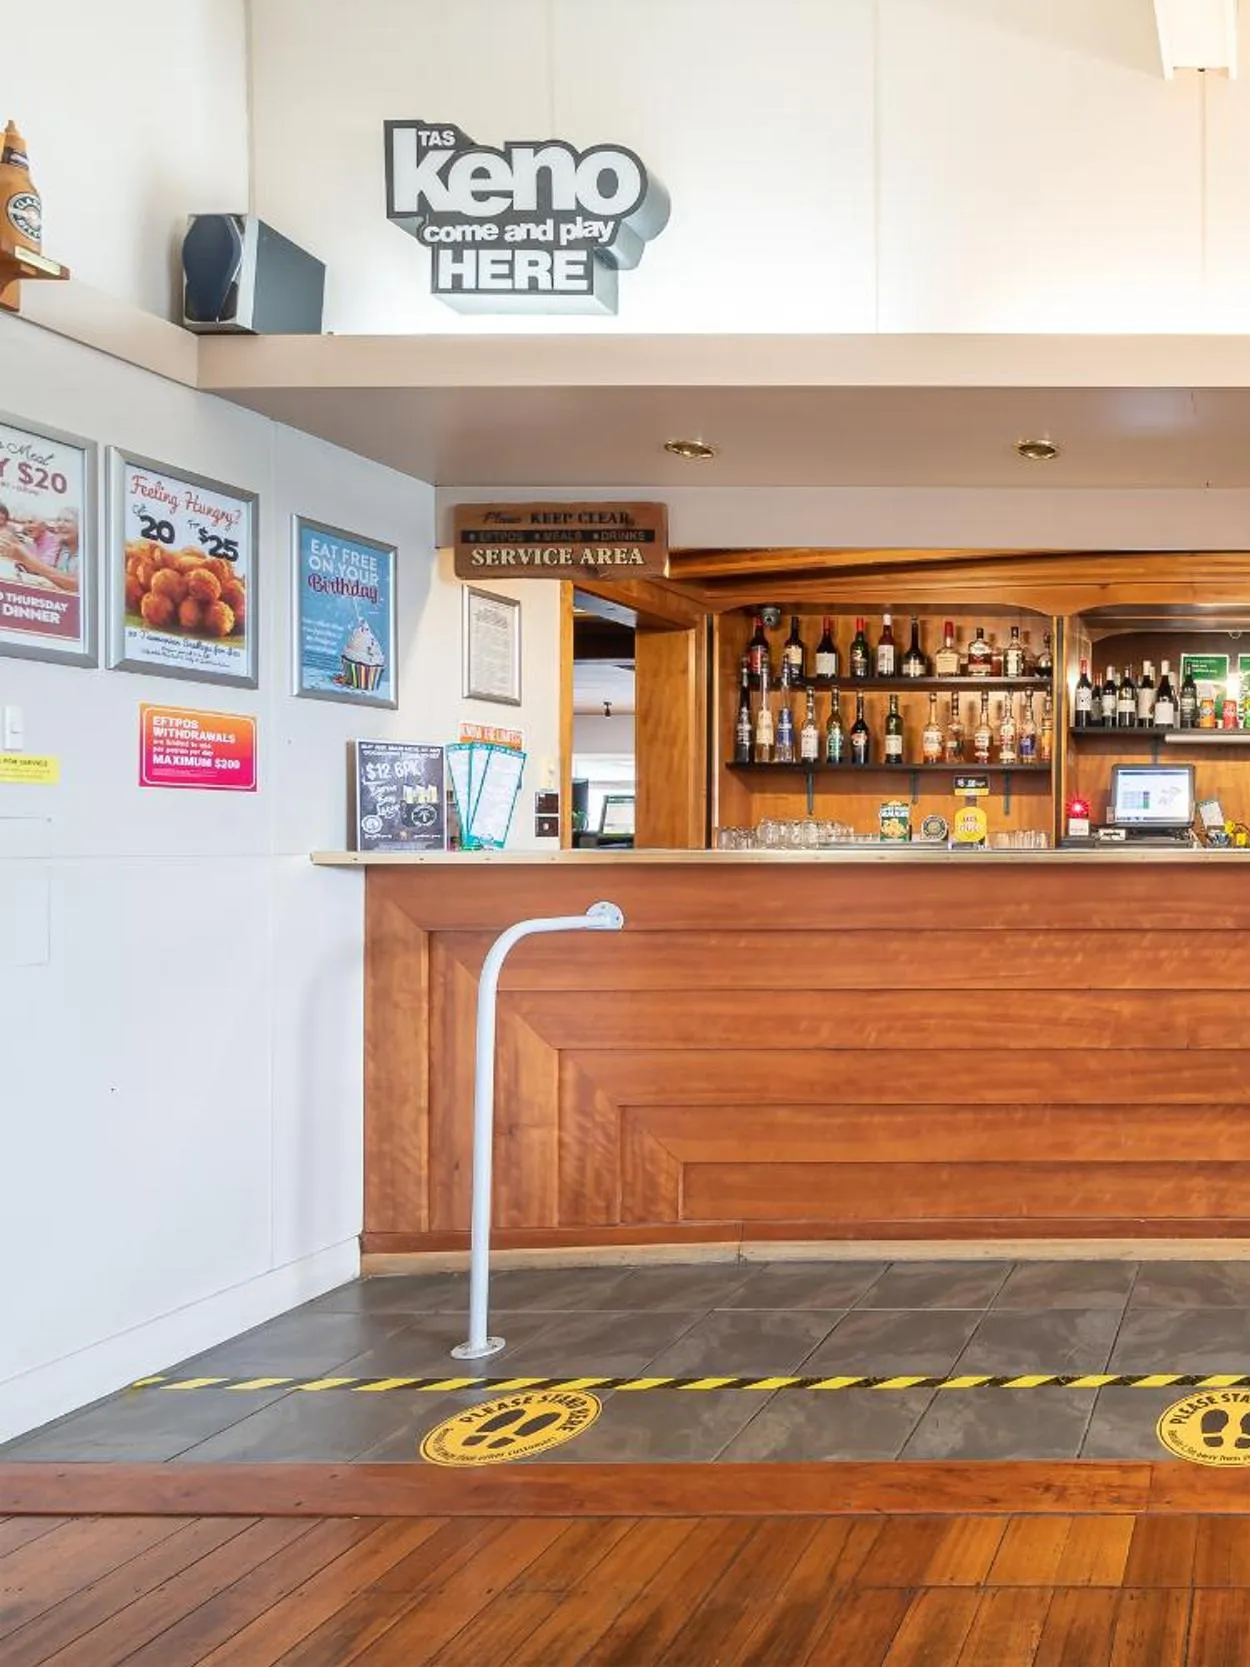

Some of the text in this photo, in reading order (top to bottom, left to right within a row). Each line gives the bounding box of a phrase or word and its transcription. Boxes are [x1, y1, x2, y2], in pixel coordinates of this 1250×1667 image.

[418, 130, 455, 146] TAS
[393, 128, 641, 217] keno
[424, 217, 614, 245] come and play
[439, 250, 588, 290] HERE
[18, 461, 67, 494] $20
[130, 475, 241, 531] Feeling Hungry?
[530, 511, 574, 524] KEEP
[577, 511, 630, 524] CLEAR
[140, 515, 175, 544] 20
[198, 527, 239, 561] $25
[601, 530, 645, 541] DRINKS
[311, 538, 377, 571] EAT FREE
[471, 547, 644, 565] SERVICE AREA
[309, 555, 378, 587] ON YOUR
[5, 592, 68, 612] THURSDAY
[308, 572, 378, 604] Birthday
[2, 603, 60, 624] DINNER
[153, 716, 199, 729] EFTPOS
[153, 726, 236, 743] WITHDRAWALS
[153, 754, 240, 769] MAXIMUM $200
[459, 1392, 590, 1432] PLEASE STAND HERE
[1169, 1395, 1218, 1424] PLEASE
